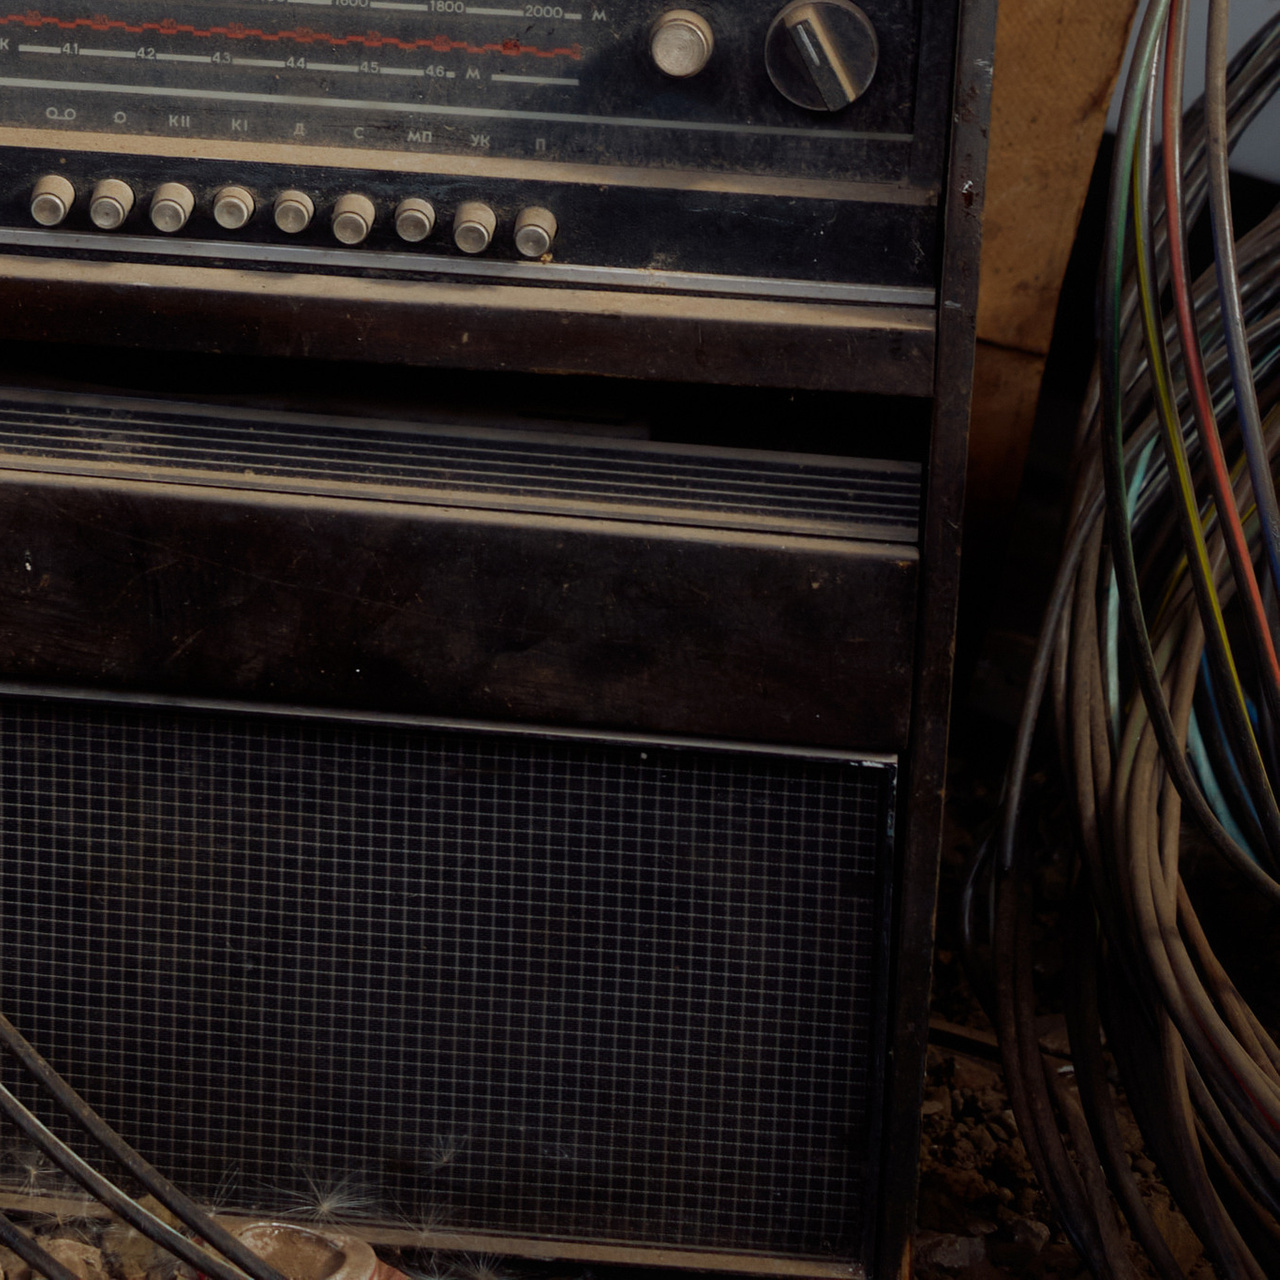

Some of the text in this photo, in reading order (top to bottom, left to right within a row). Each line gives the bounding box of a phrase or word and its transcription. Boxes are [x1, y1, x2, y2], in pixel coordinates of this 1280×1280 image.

[430, 0, 464, 13] 1800
[525, 5, 563, 18] 2000
[592, 10, 607, 21] М
[465, 67, 480, 80] М
[293, 122, 305, 137] Д
[407, 130, 432, 143] МП
[470, 133, 491, 149] УК
[535, 138, 546, 151] П
